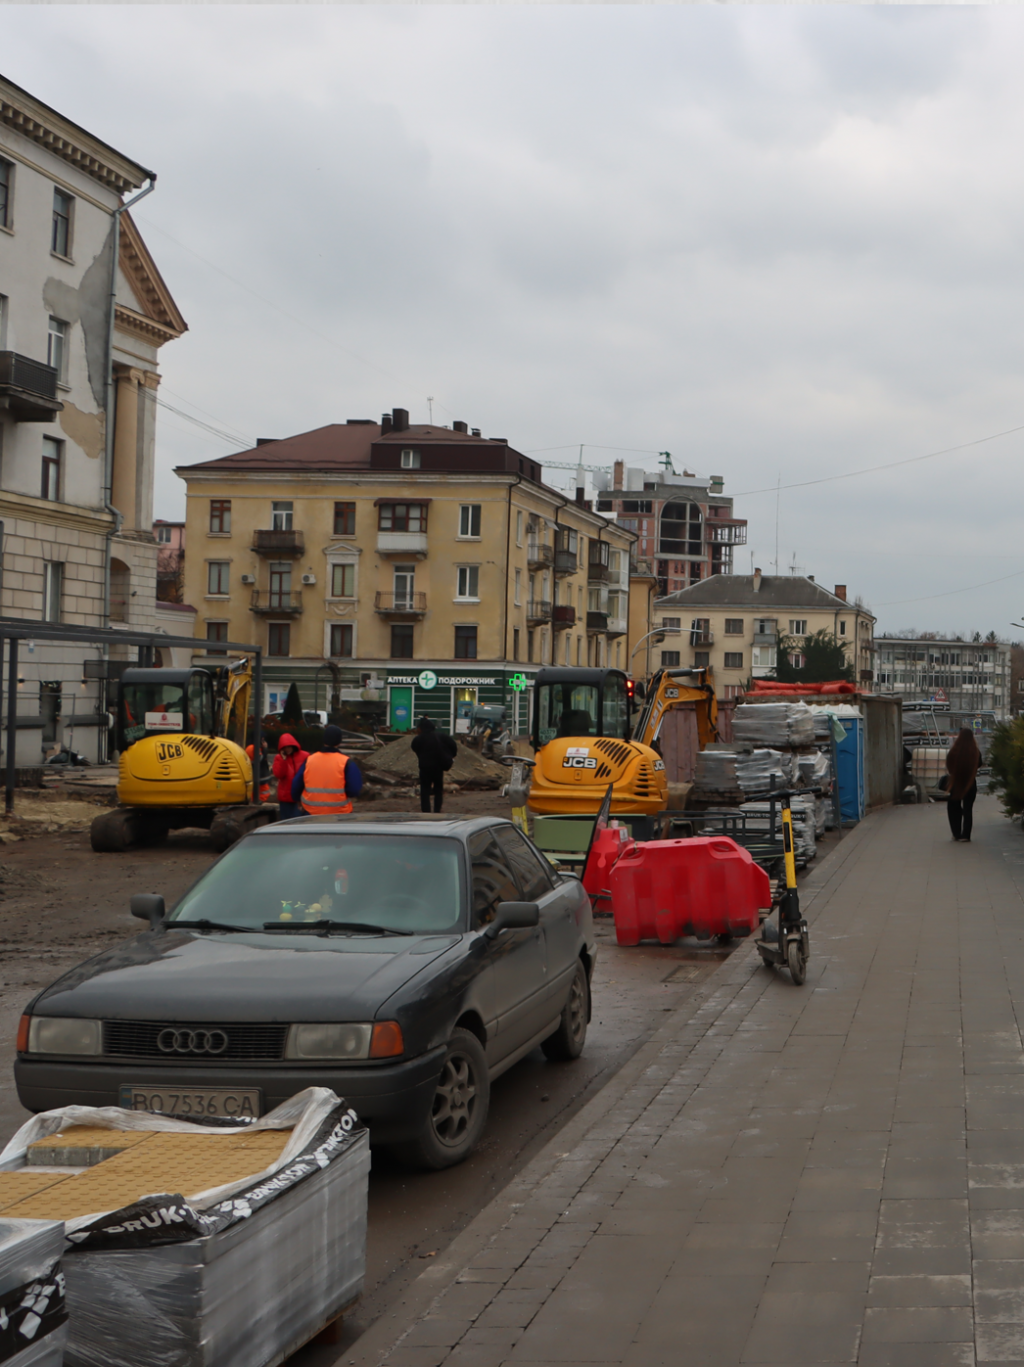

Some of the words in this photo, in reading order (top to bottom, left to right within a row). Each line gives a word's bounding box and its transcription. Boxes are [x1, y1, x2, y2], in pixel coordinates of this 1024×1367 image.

[387, 676, 418, 684] АПТЕКА
[438, 677, 496, 685] ПОДОРОЖНИК
[665, 688, 679, 698] JCB
[158, 743, 182, 761] JCB
[563, 757, 597, 769] JCB
[169, 1094, 217, 1114] 7536
[223, 1095, 254, 1115] CA
